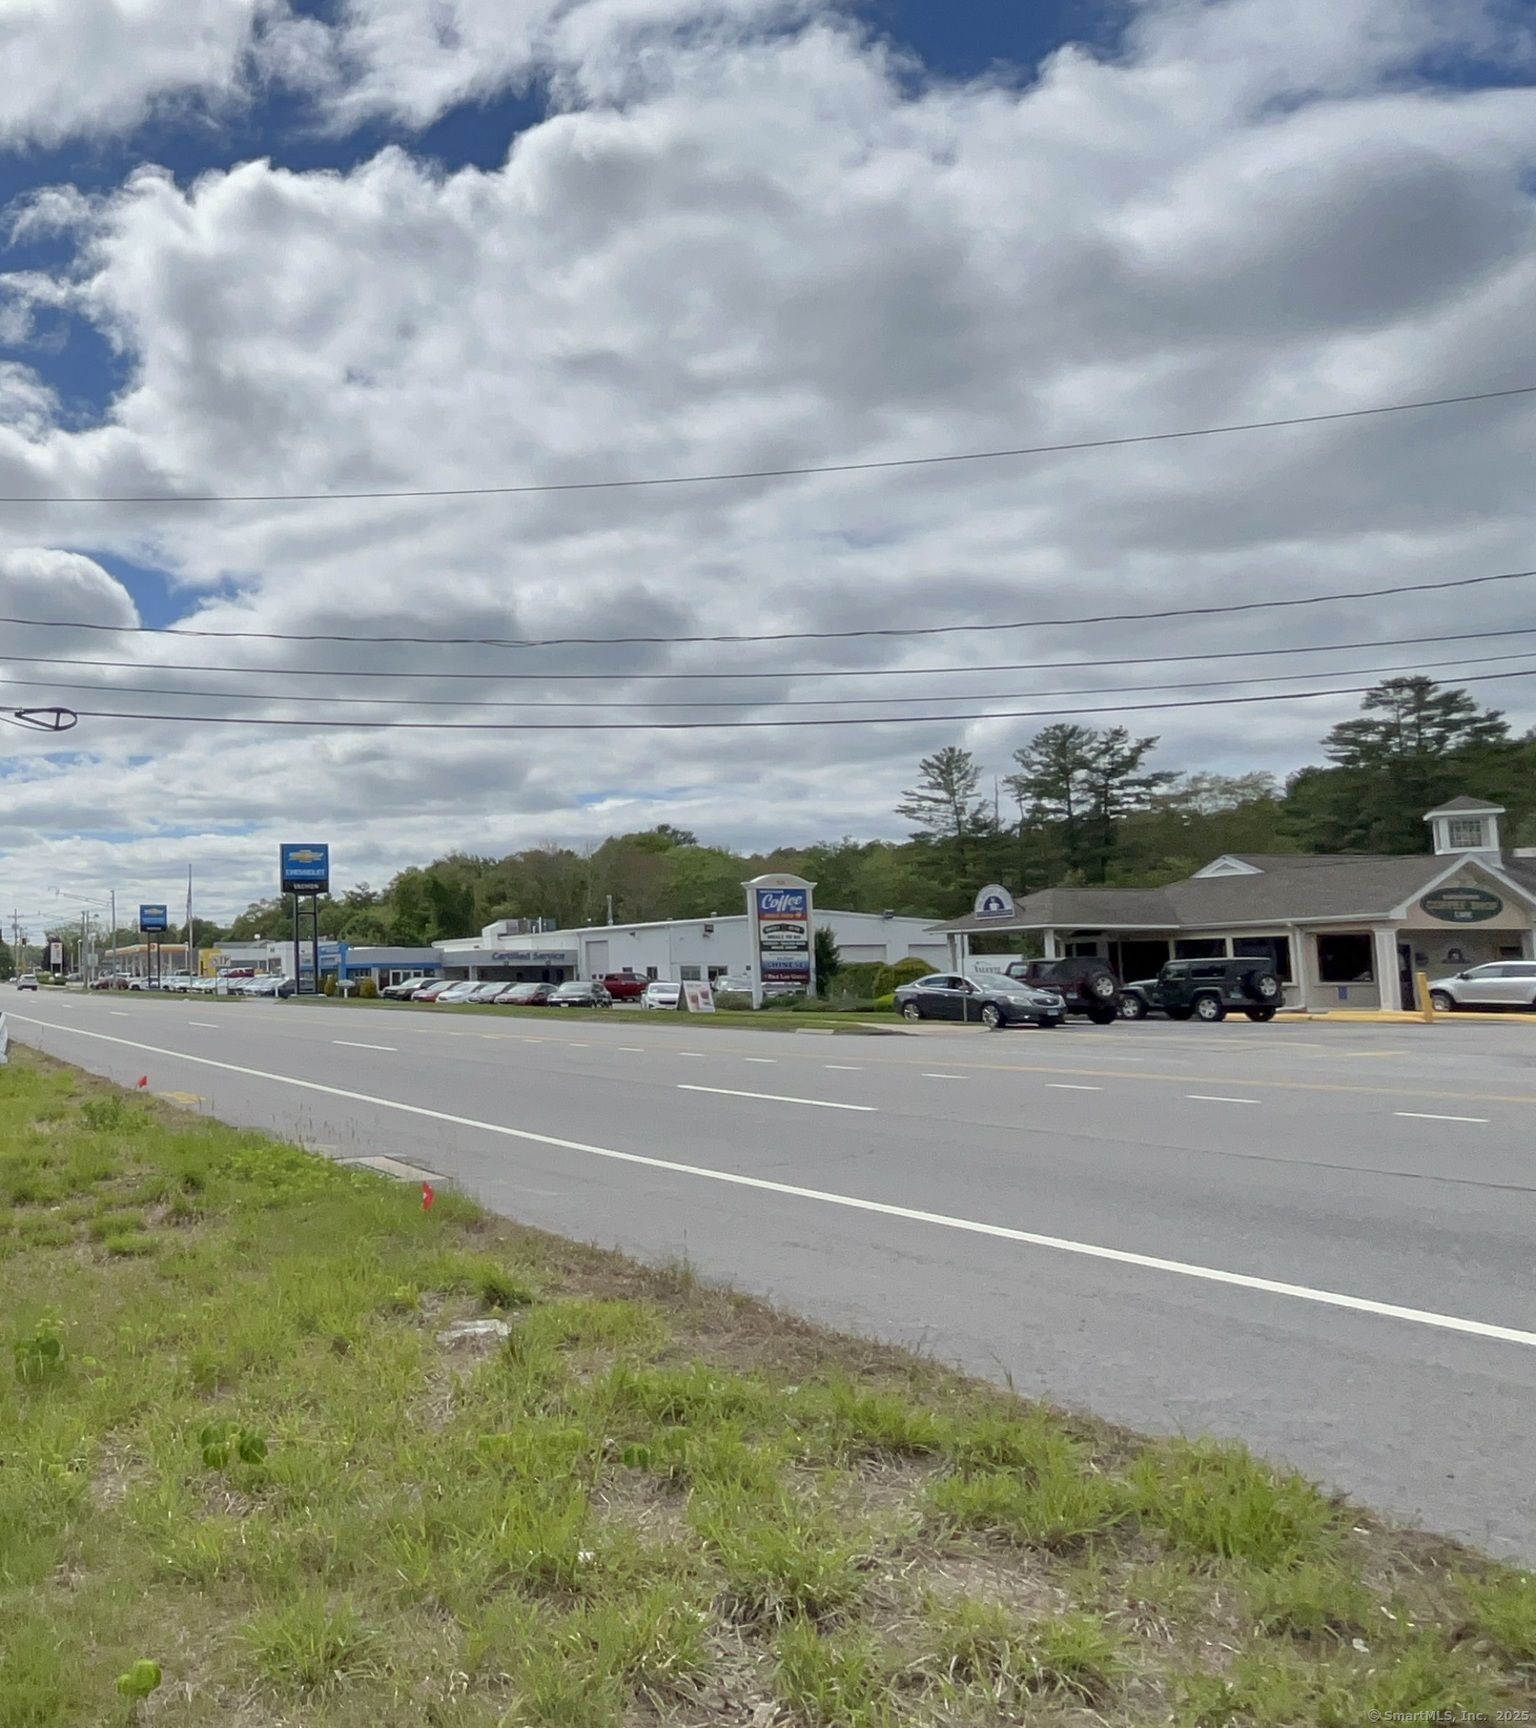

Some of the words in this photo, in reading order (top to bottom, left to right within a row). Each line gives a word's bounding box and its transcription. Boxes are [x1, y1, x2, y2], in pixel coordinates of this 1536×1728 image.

[285, 868, 325, 876] CHEVROLET
[762, 894, 803, 912] Coffee
[492, 951, 531, 960] Certified
[532, 951, 566, 960] Service
